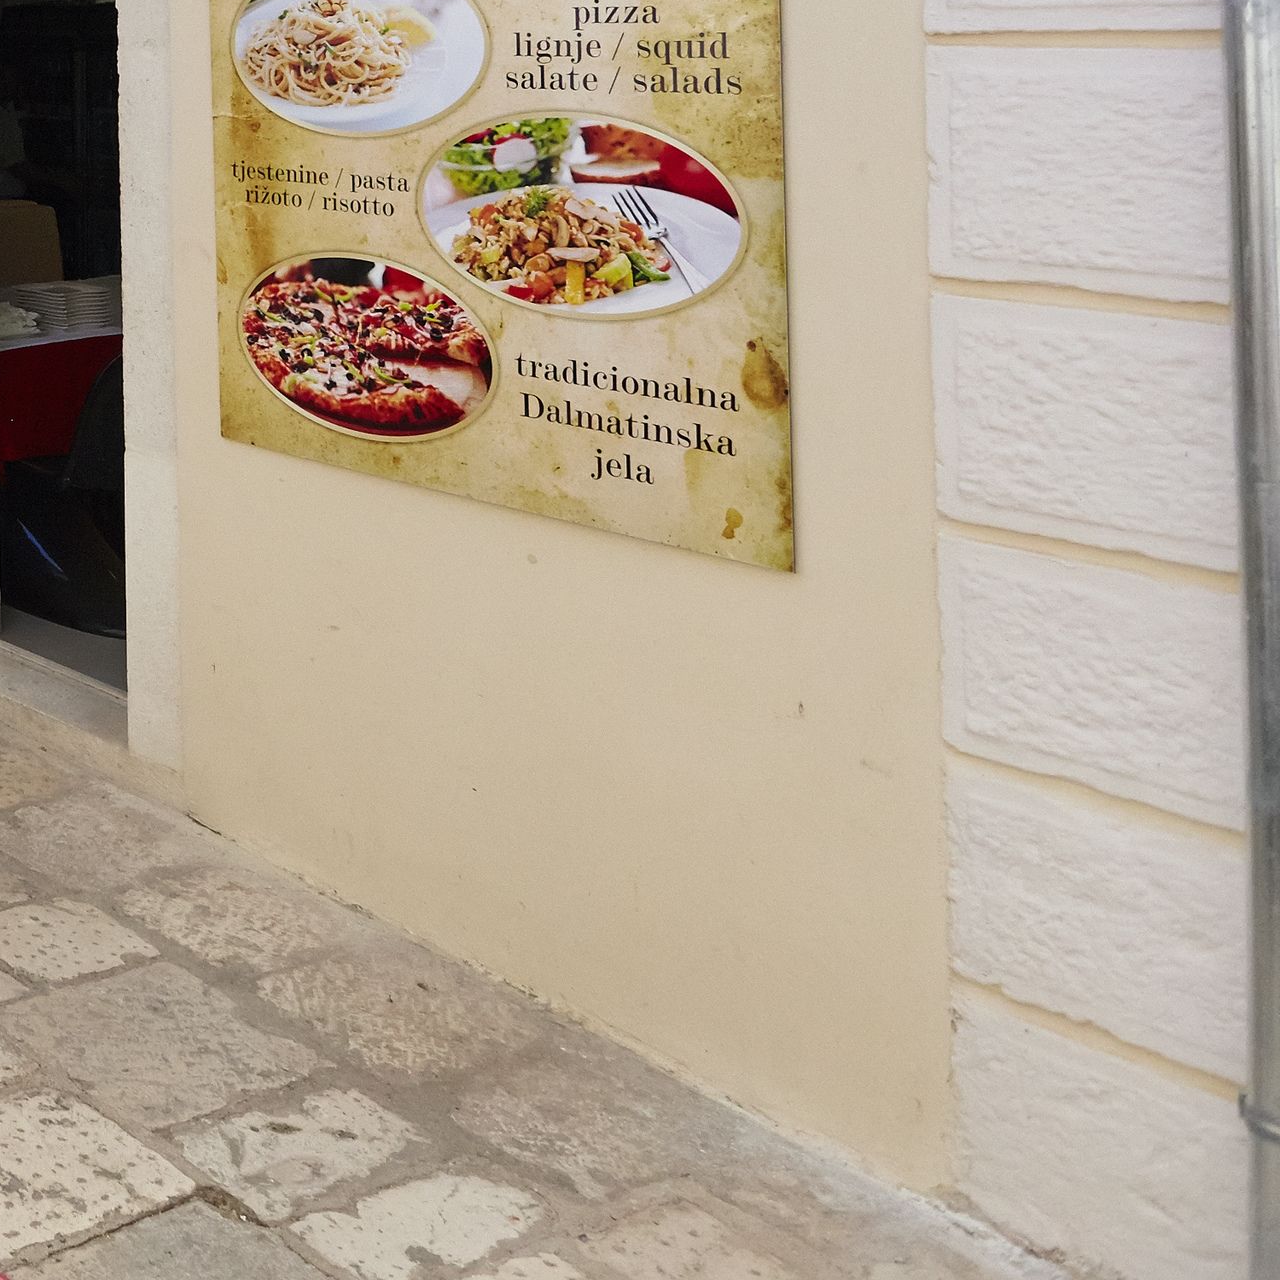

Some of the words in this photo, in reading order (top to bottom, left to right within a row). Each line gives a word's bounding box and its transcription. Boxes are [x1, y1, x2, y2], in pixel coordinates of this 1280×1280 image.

[572, 0, 661, 31] pizza
[513, 31, 603, 65] lignje
[636, 31, 731, 70] squid
[505, 64, 599, 93] salate
[632, 67, 744, 96] salads
[230, 159, 330, 187] tjestenine
[349, 170, 411, 194] pasta
[244, 184, 303, 209] rižoto
[321, 192, 395, 218] risotto
[514, 351, 740, 413] tradicionalna
[519, 391, 737, 458] Dalmatinska
[590, 447, 654, 486] jela
